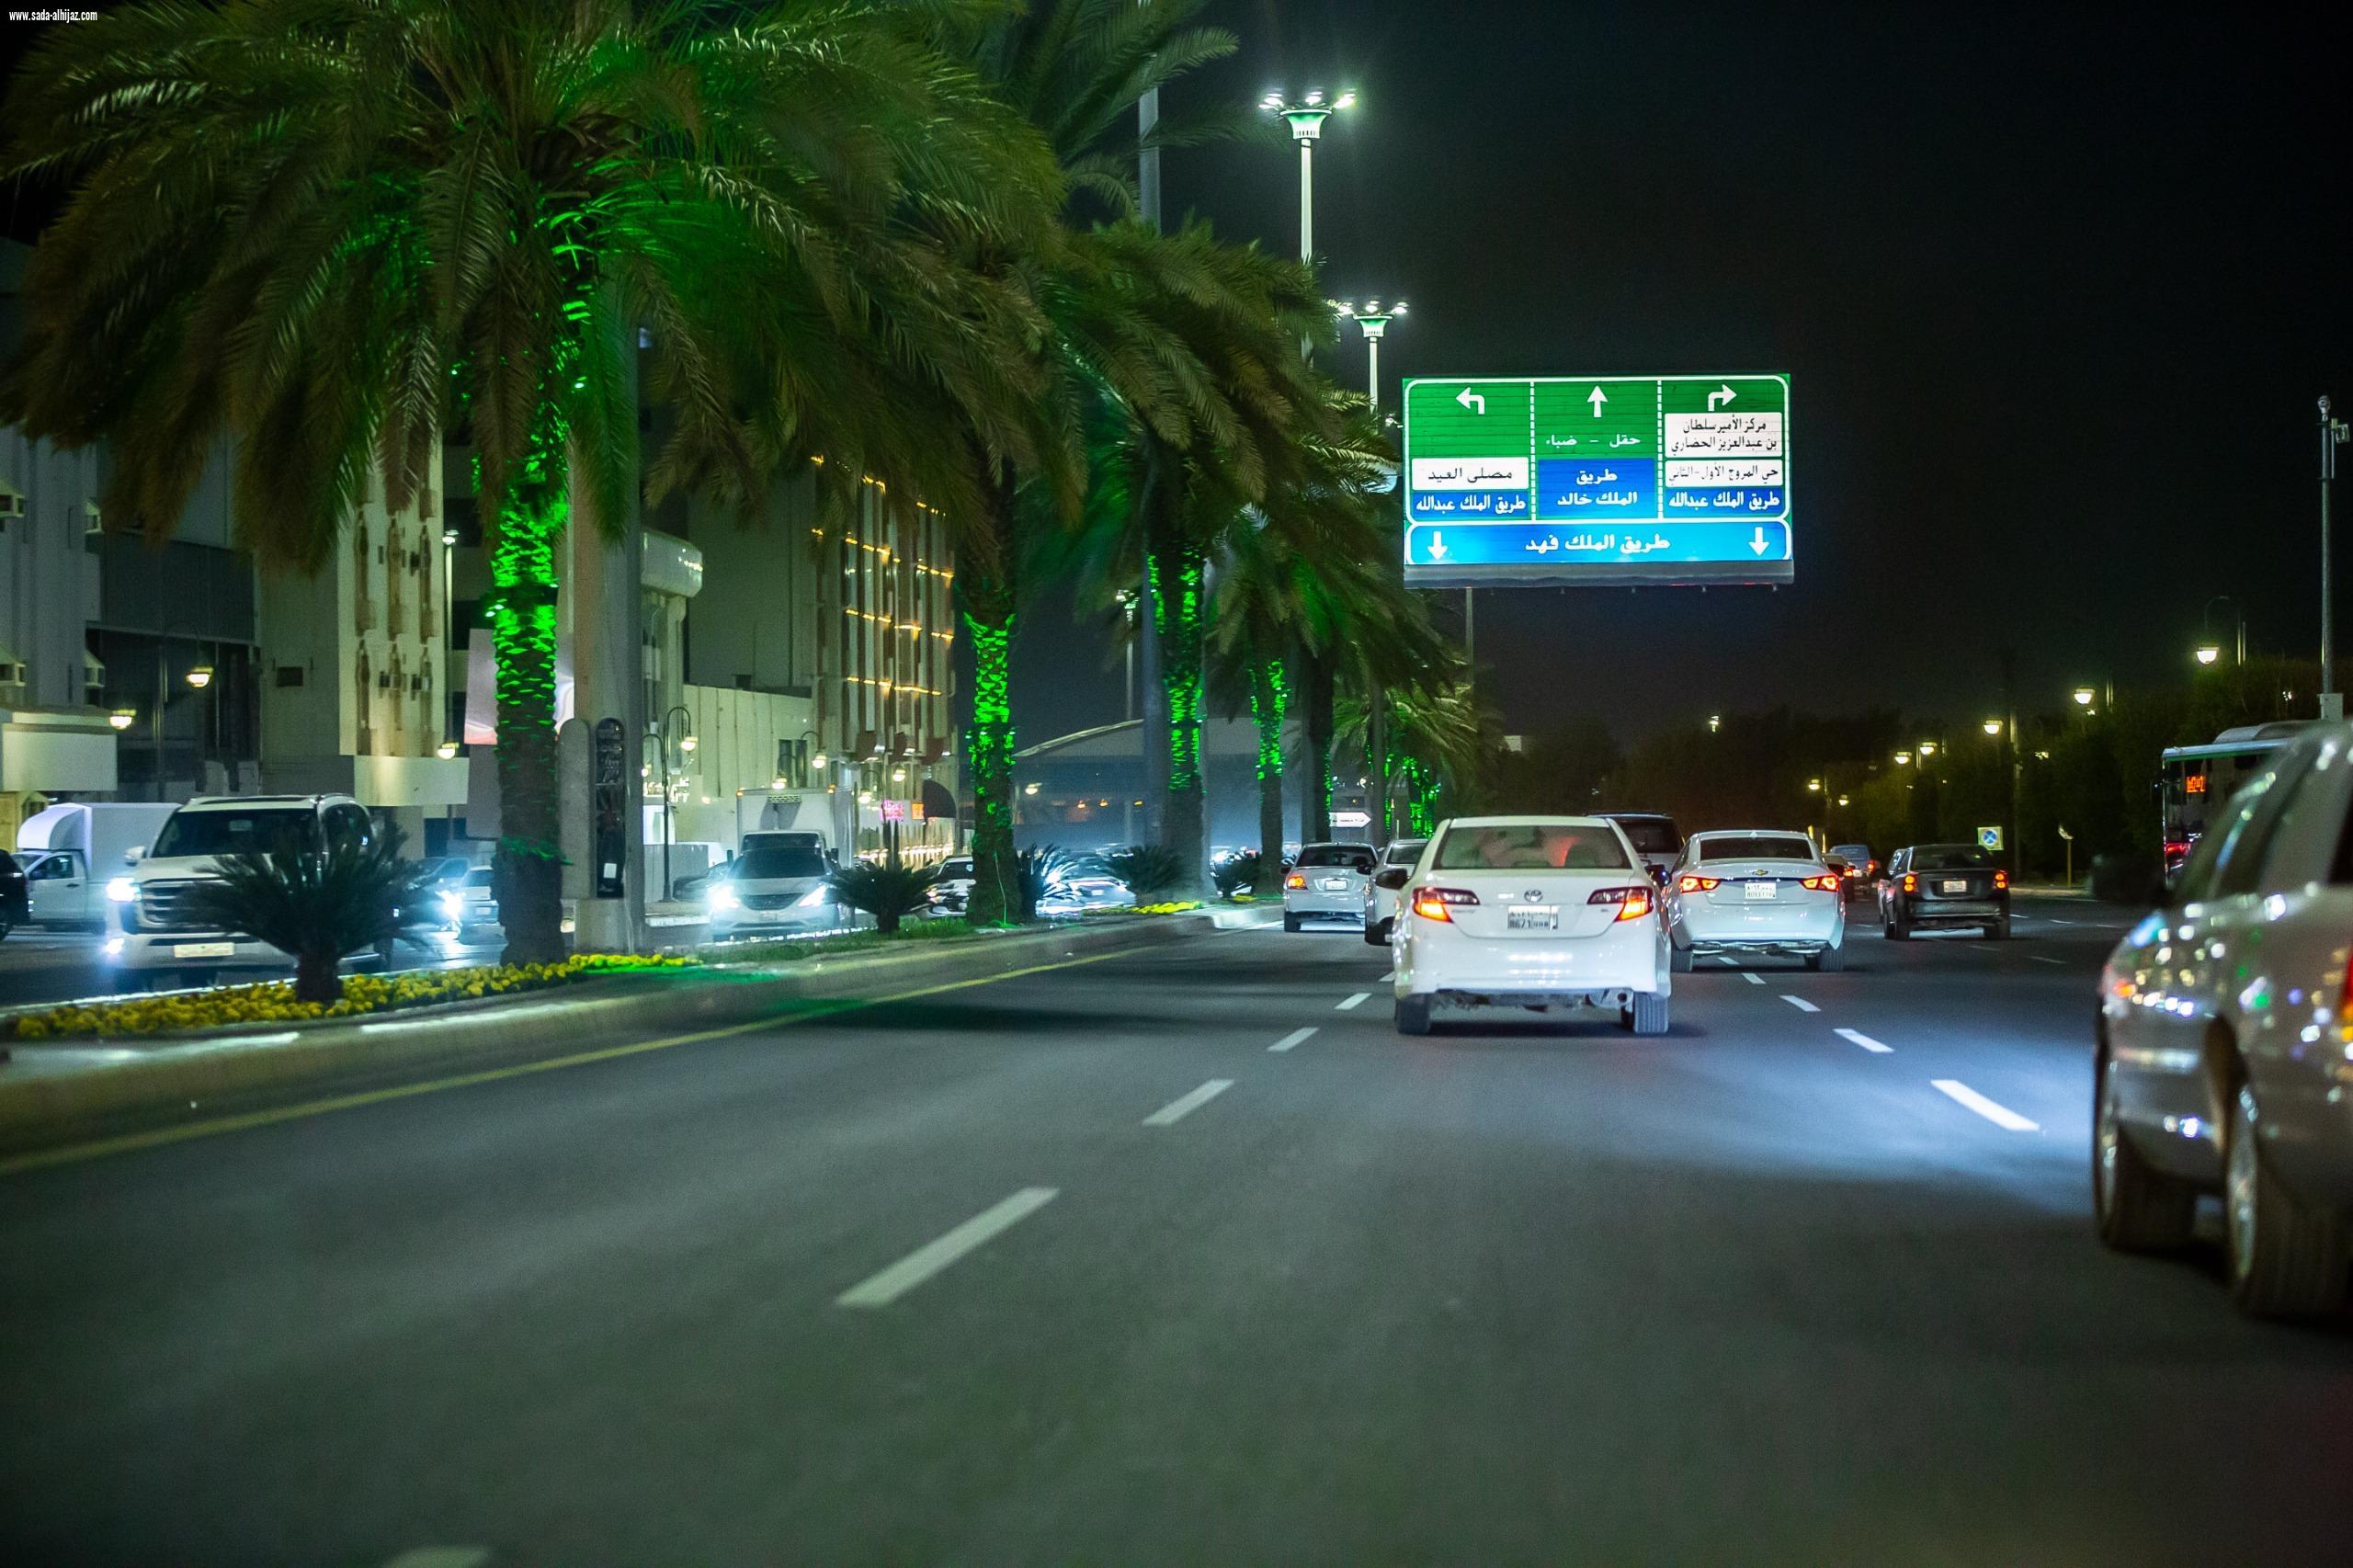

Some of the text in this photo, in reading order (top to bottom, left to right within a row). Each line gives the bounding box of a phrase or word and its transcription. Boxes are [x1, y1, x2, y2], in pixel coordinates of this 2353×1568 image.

[1683, 418, 1716, 433] سلطان
[1745, 417, 1767, 433] مركز
[1608, 433, 1641, 449] حقل
[1671, 436, 1715, 456] الحضاري
[1767, 438, 1778, 450] بن
[1427, 467, 1513, 483] مصلى العيد
[1575, 468, 1618, 485] طريق
[1728, 465, 1758, 481] المروج
[1762, 469, 1779, 484] حي
[1415, 494, 1527, 514] طريق الملك عبدالله
[1557, 491, 1638, 506] الملك خالد
[1668, 491, 1780, 511] طريق الملك عبدالله
[1525, 533, 1671, 554] طريق الملك فهد
